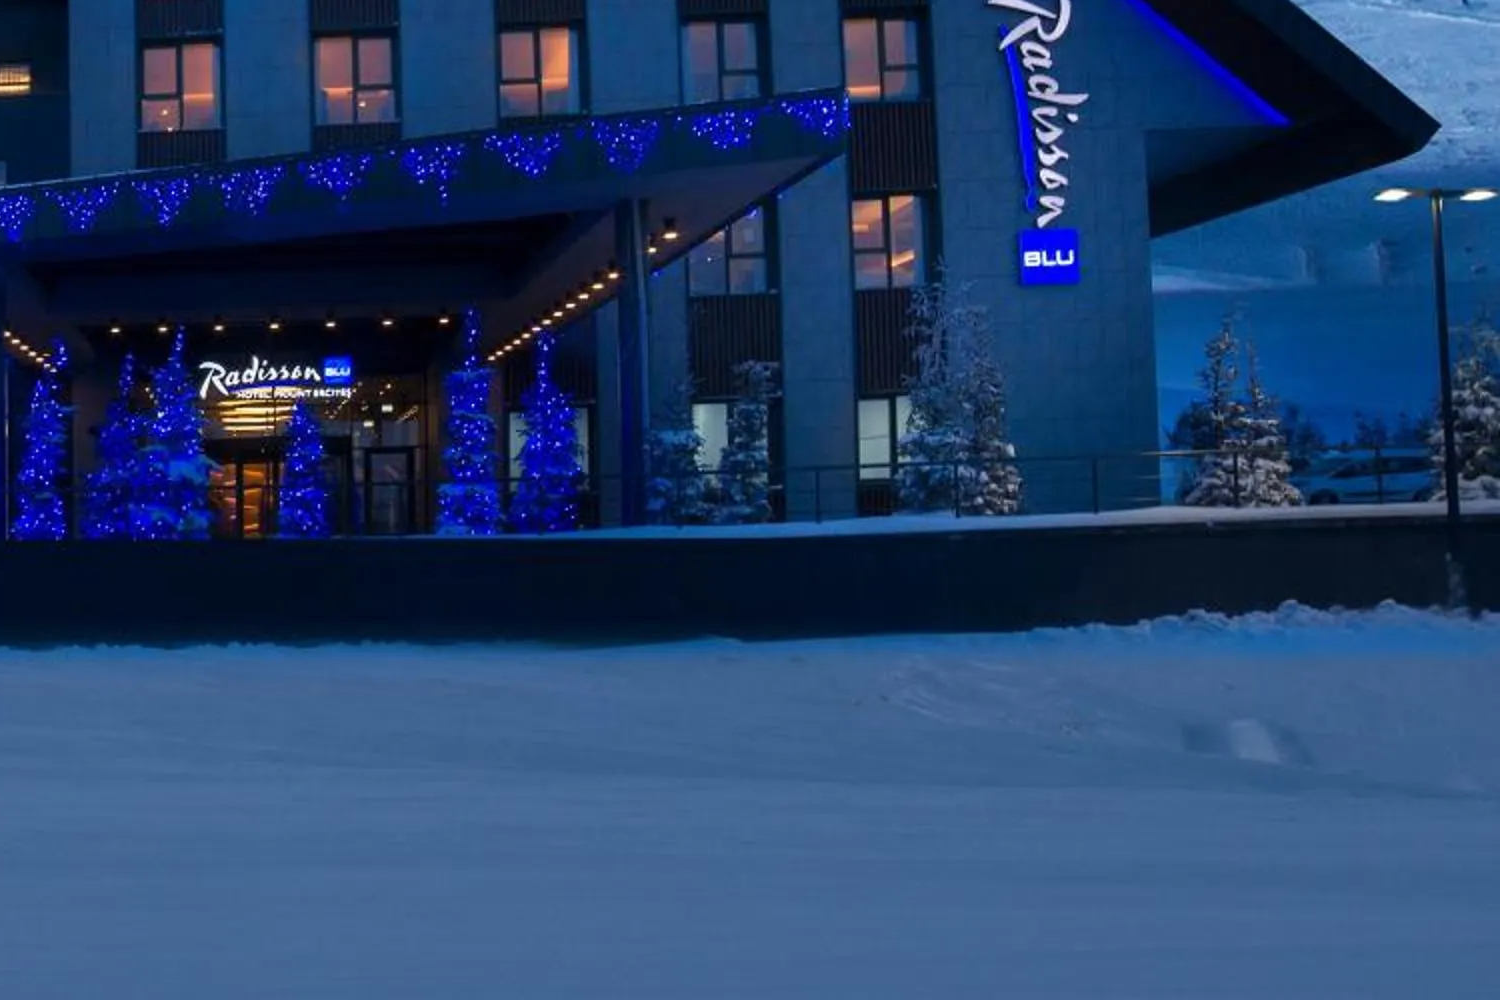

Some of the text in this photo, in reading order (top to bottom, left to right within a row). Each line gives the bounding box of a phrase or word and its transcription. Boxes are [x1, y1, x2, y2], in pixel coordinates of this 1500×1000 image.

[1022, 249, 1076, 268] BLU
[199, 355, 351, 400] Radisson BLU
